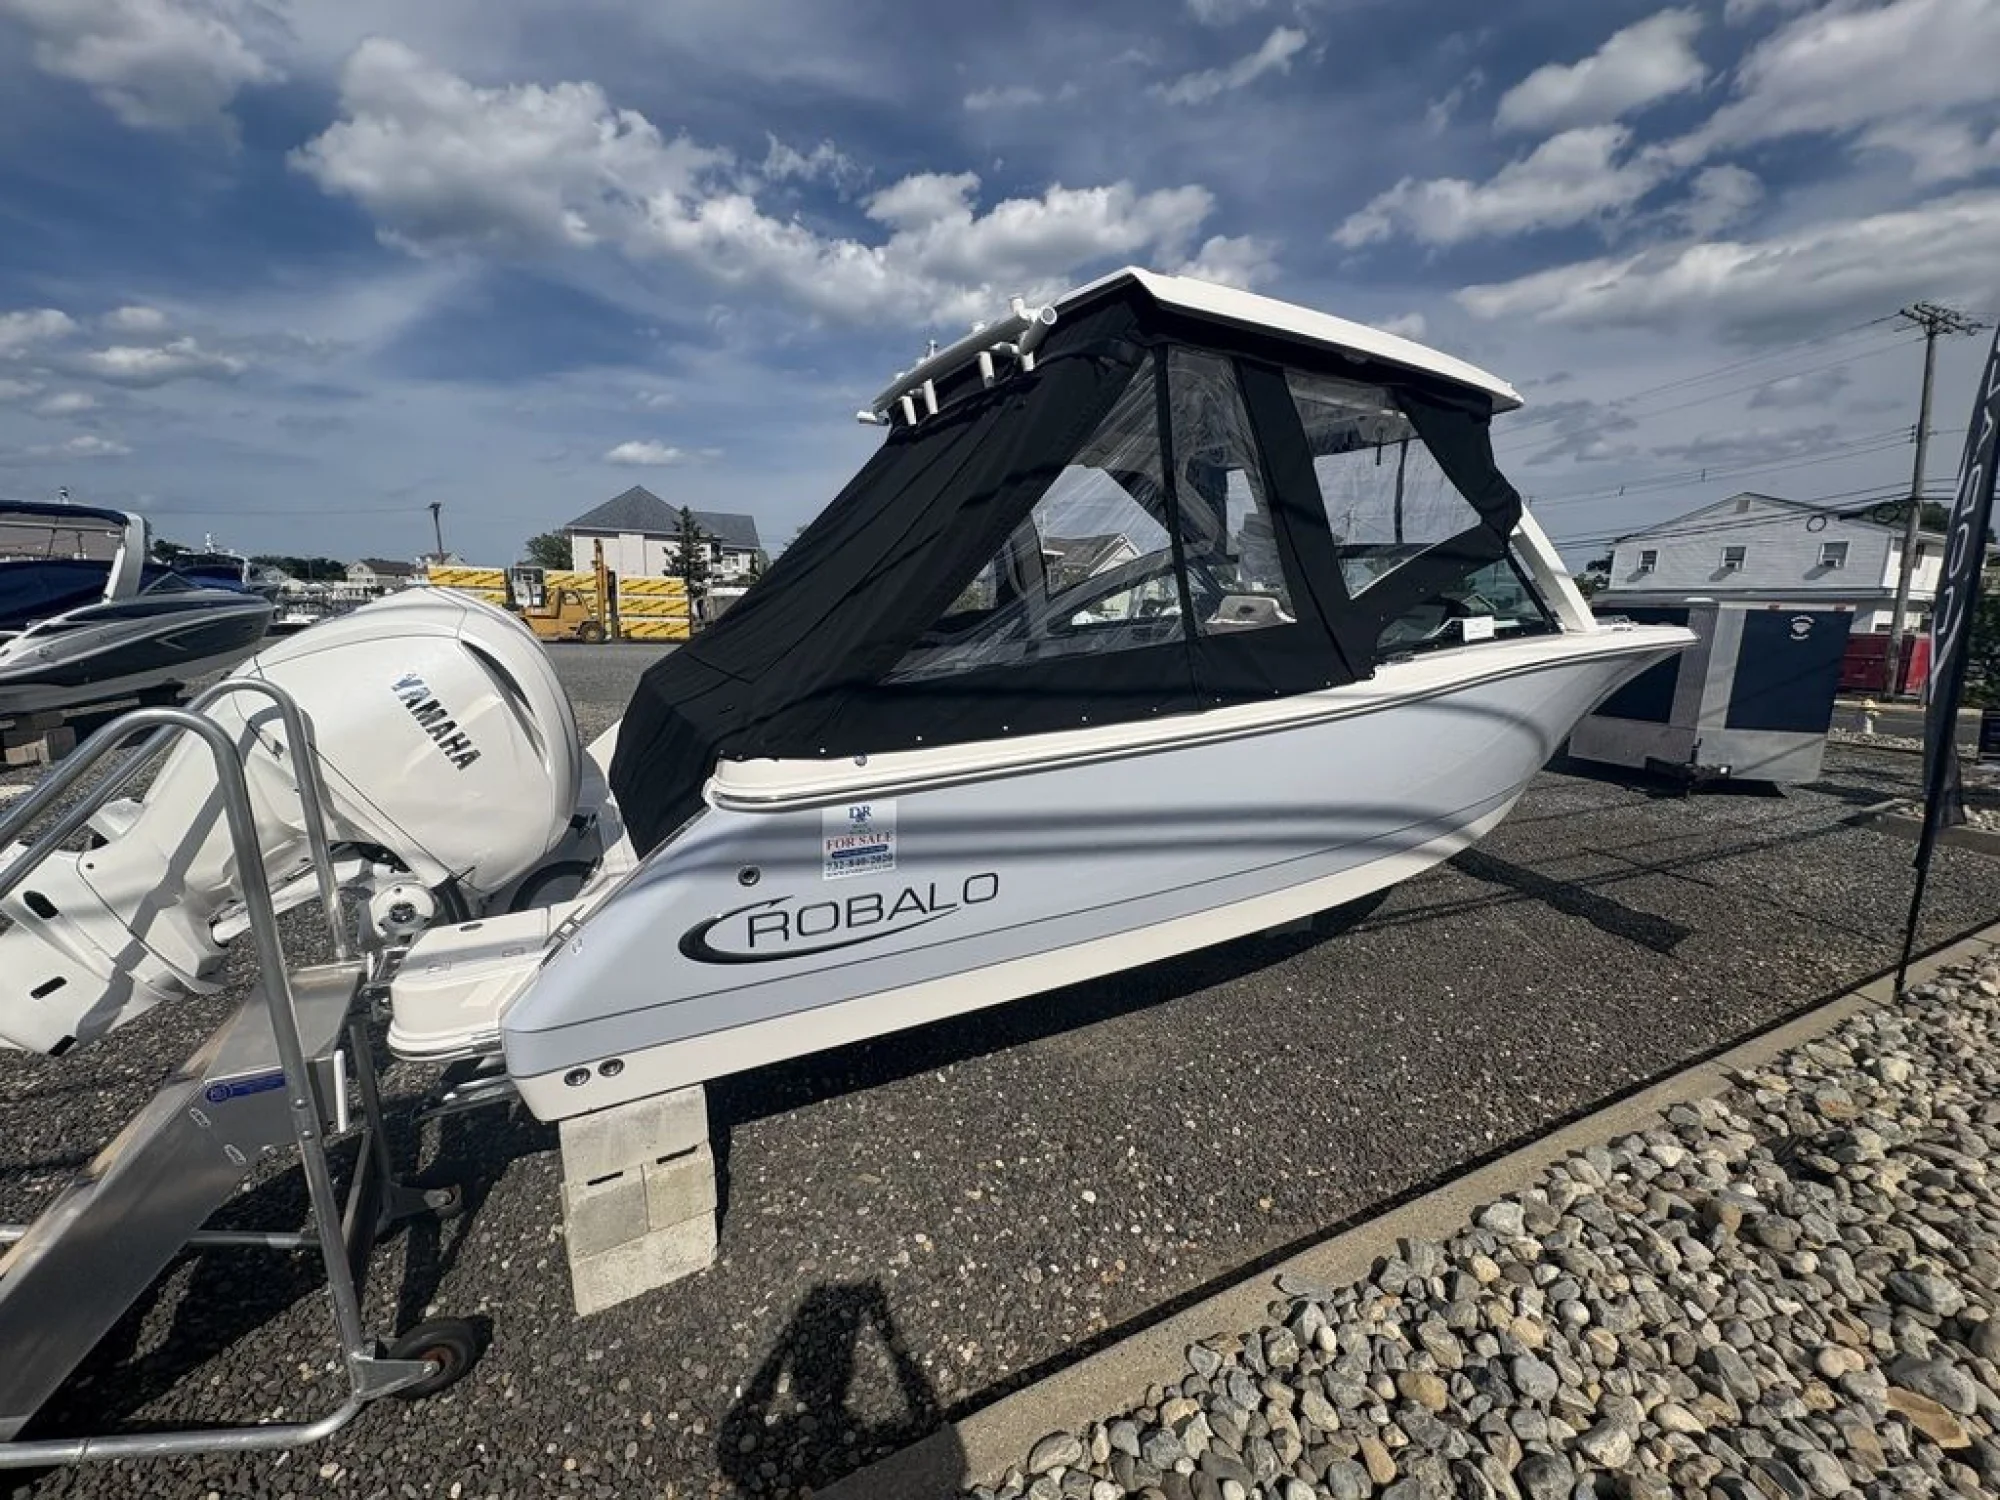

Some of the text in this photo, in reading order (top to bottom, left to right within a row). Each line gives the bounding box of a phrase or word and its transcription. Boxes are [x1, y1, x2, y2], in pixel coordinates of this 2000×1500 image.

[391, 673, 480, 770] YAMAHA
[827, 831, 891, 850] FOR SALE
[747, 872, 999, 948] ROBALO
